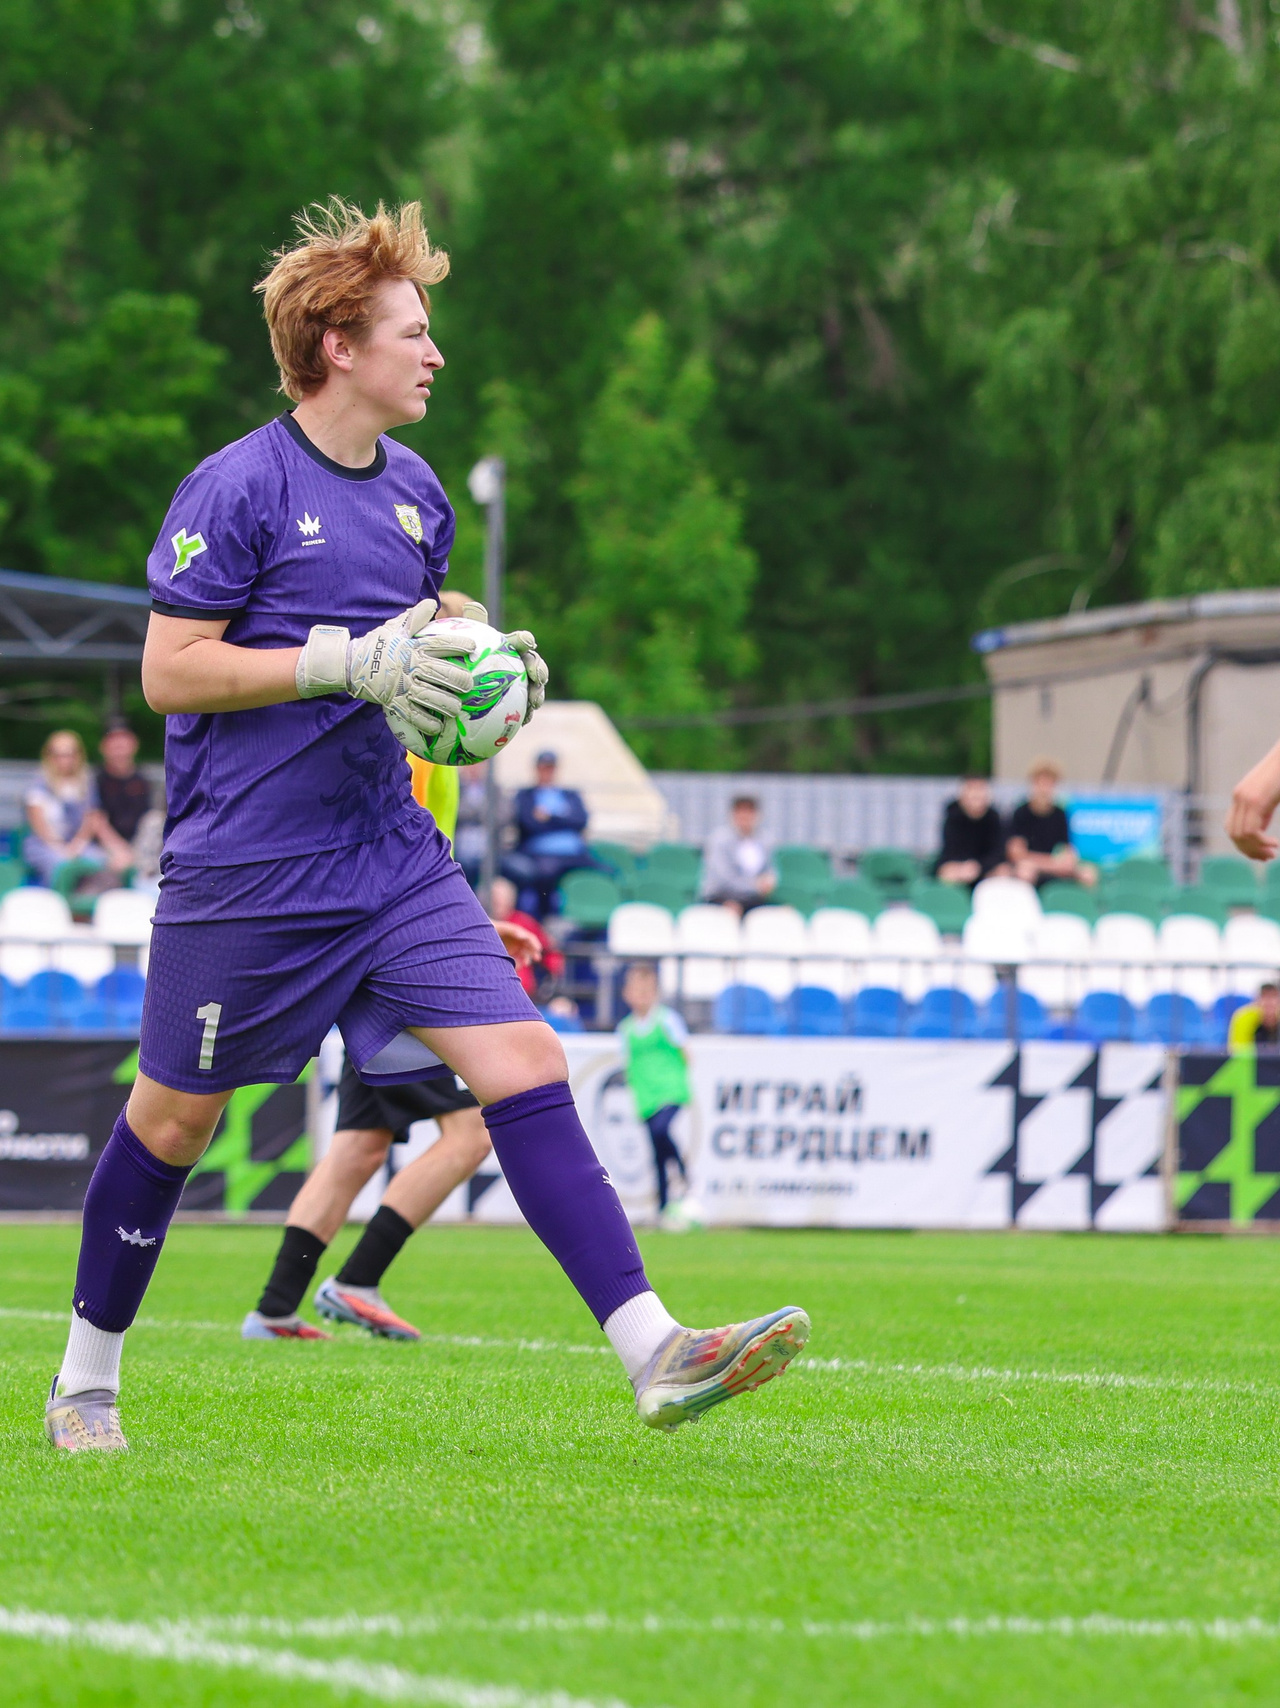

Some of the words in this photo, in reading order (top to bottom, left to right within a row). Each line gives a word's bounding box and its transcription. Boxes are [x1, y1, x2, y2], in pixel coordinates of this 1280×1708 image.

[370, 635, 387, 680] JÖGEL
[196, 1002, 222, 1070] 1
[715, 1073, 866, 1115] ИГРАЙ
[711, 1124, 933, 1166] СЕРДЦЕМ
